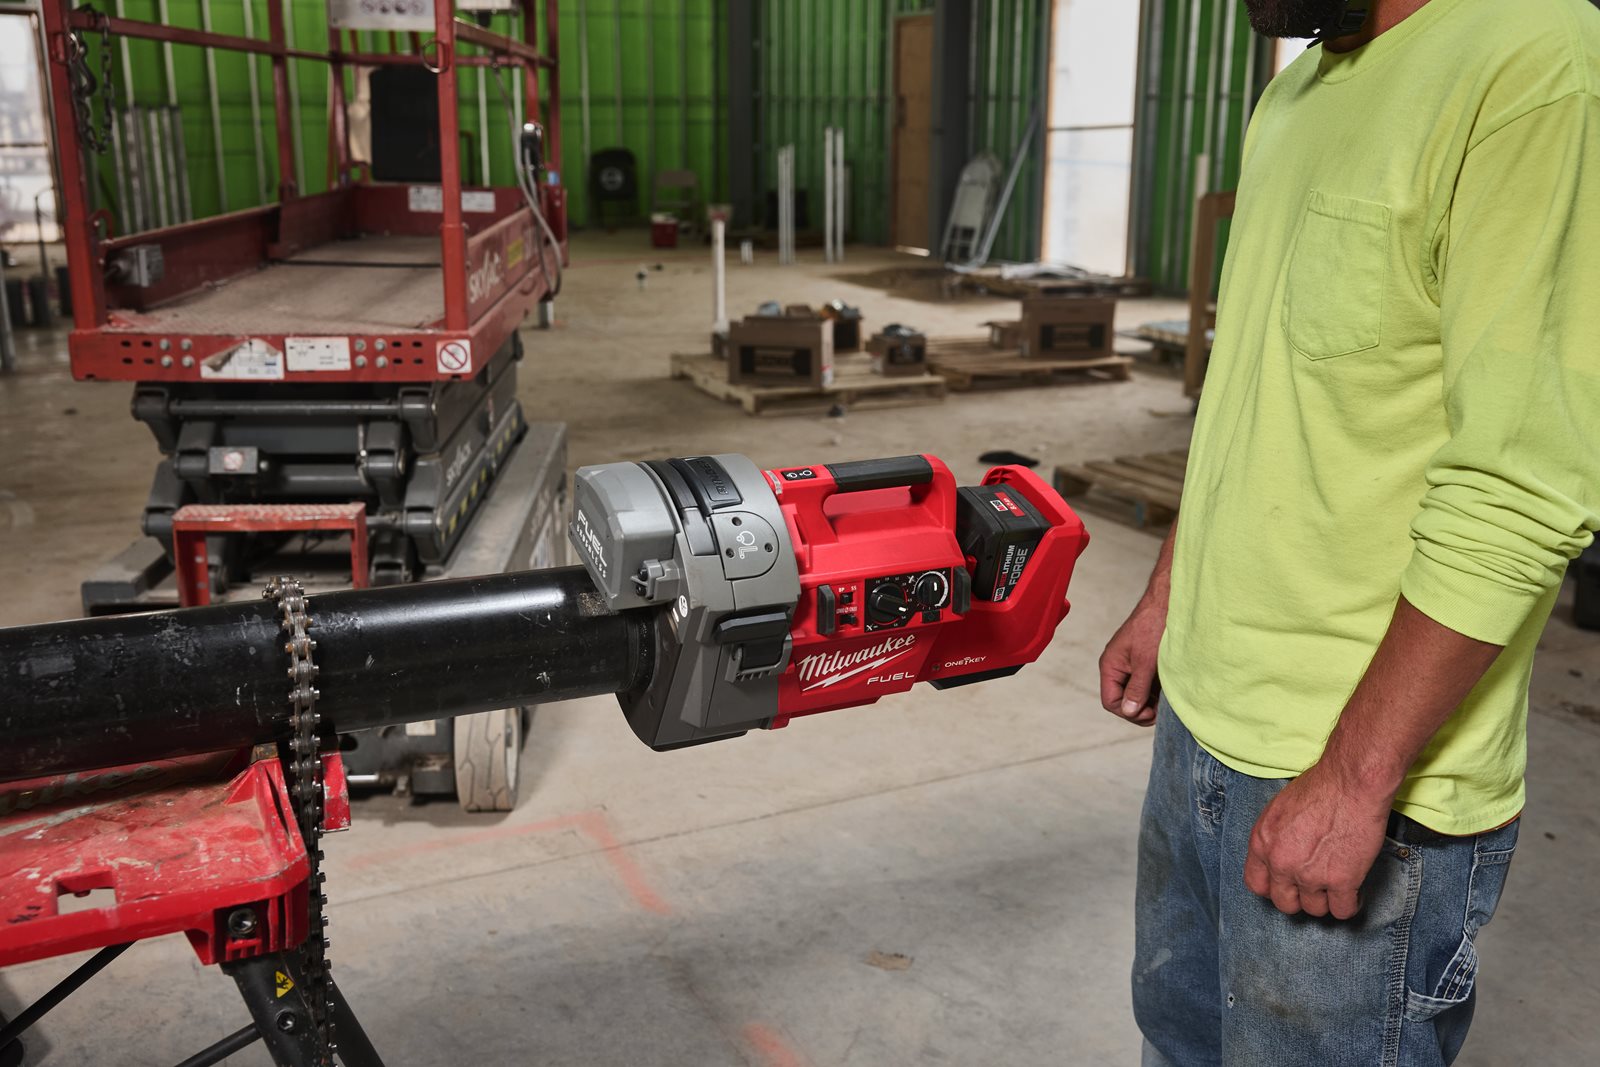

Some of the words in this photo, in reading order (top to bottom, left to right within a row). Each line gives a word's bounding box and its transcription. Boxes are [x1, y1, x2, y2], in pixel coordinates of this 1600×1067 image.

[577, 509, 608, 567] FUEL
[1008, 548, 1028, 586] FORGE
[797, 634, 915, 682] Milwaukee
[866, 671, 914, 685] FUEL
